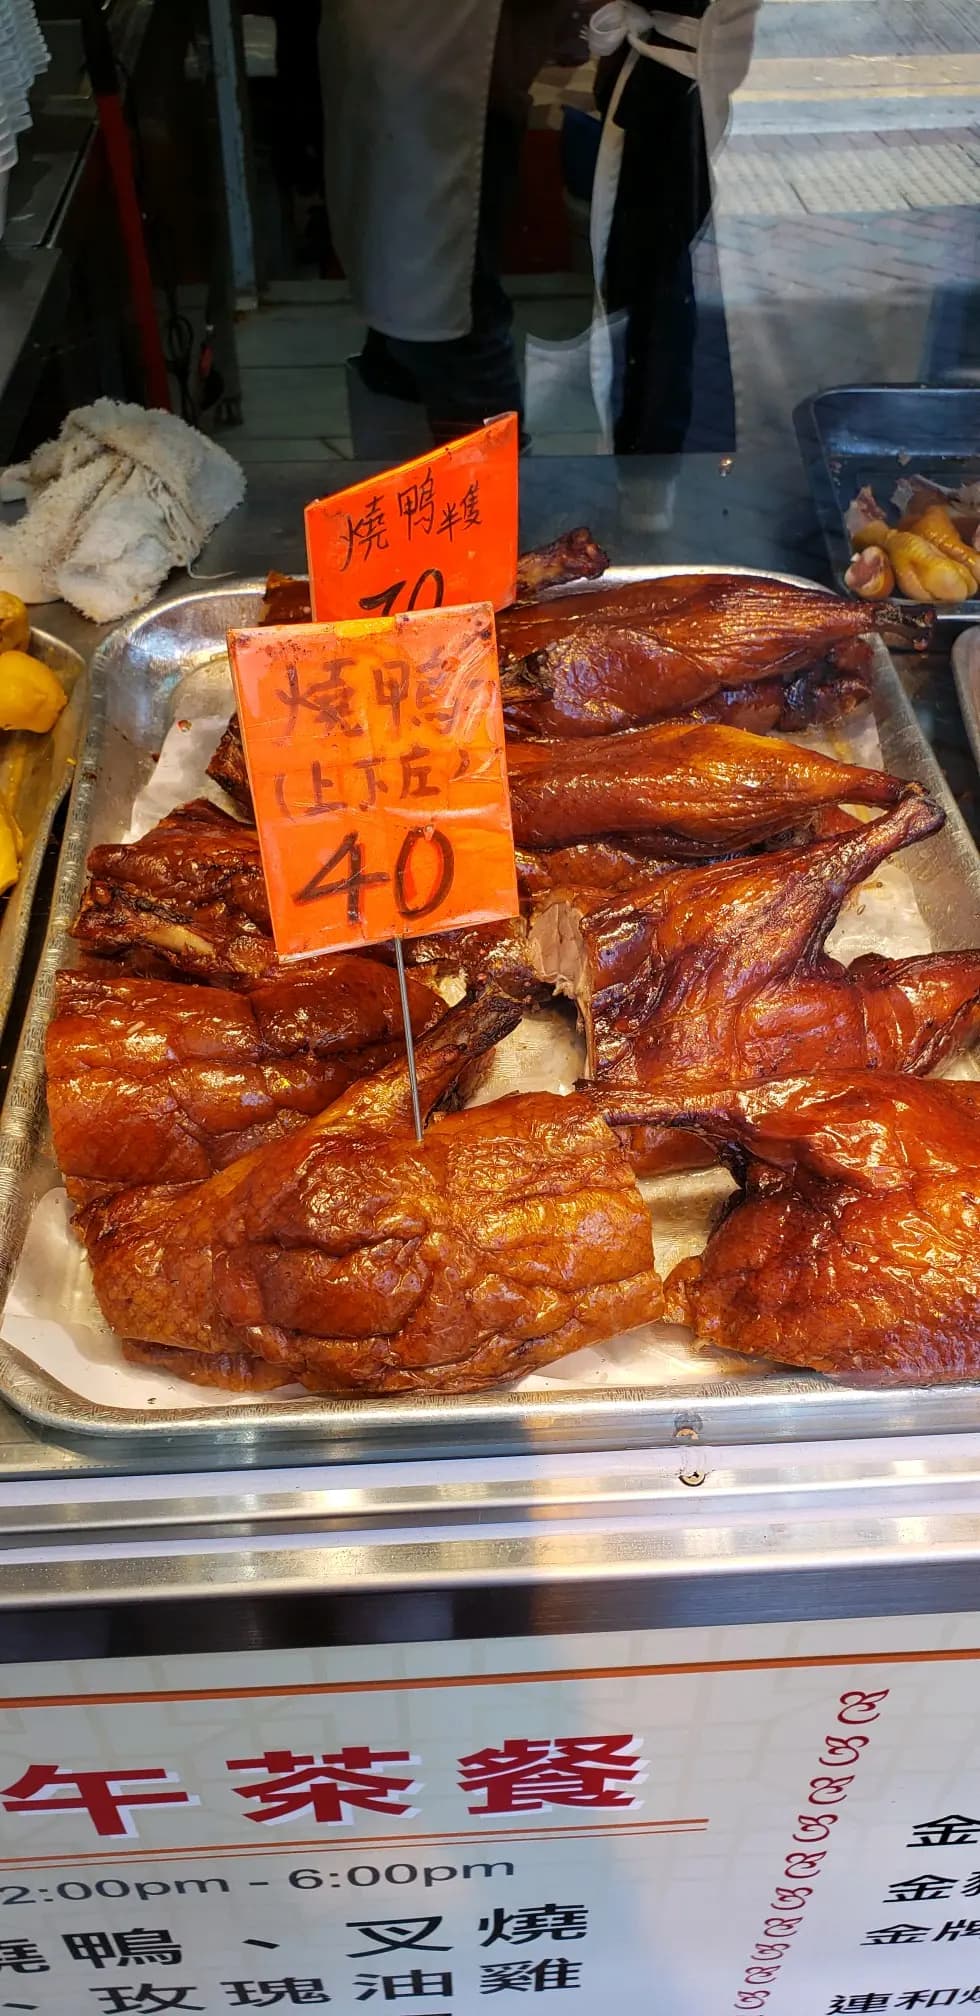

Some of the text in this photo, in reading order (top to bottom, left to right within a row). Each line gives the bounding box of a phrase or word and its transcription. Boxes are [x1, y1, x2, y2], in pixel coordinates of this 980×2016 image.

[292, 829, 456, 925] 40
[0, 1734, 641, 1836] 午茶餐
[288, 1861, 514, 1890] 6:00pm
